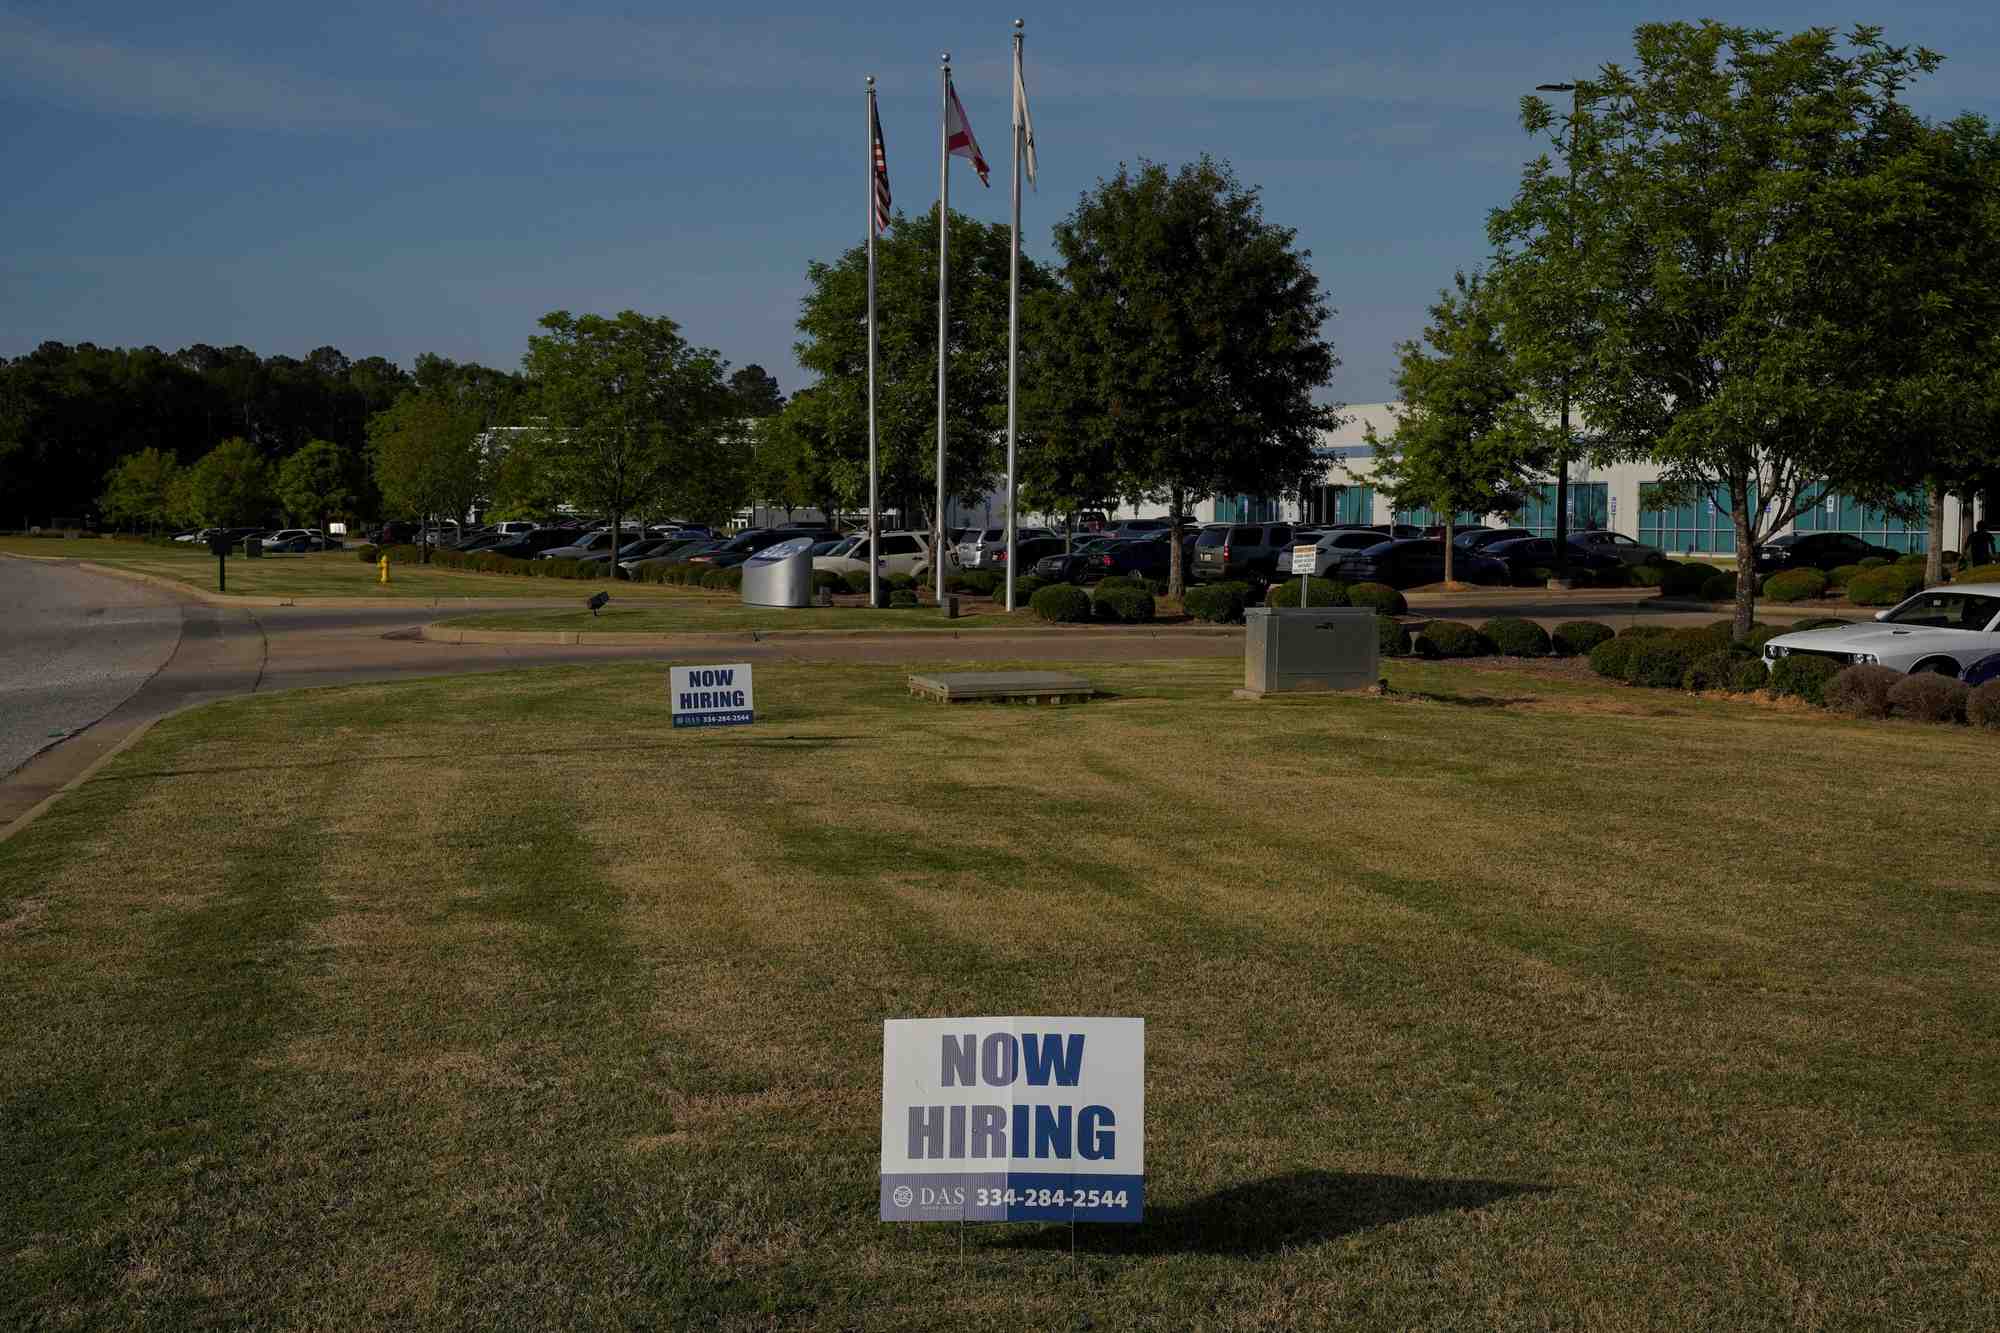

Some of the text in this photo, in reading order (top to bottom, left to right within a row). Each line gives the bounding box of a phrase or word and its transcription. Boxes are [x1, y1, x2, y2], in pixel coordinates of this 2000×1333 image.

[689, 669, 734, 687] NOW
[680, 690, 745, 709] HIRING
[941, 1032, 1085, 1087] NOW
[908, 1104, 1116, 1160] HIRING
[920, 1187, 1129, 1208] DAS 334-284-2544
